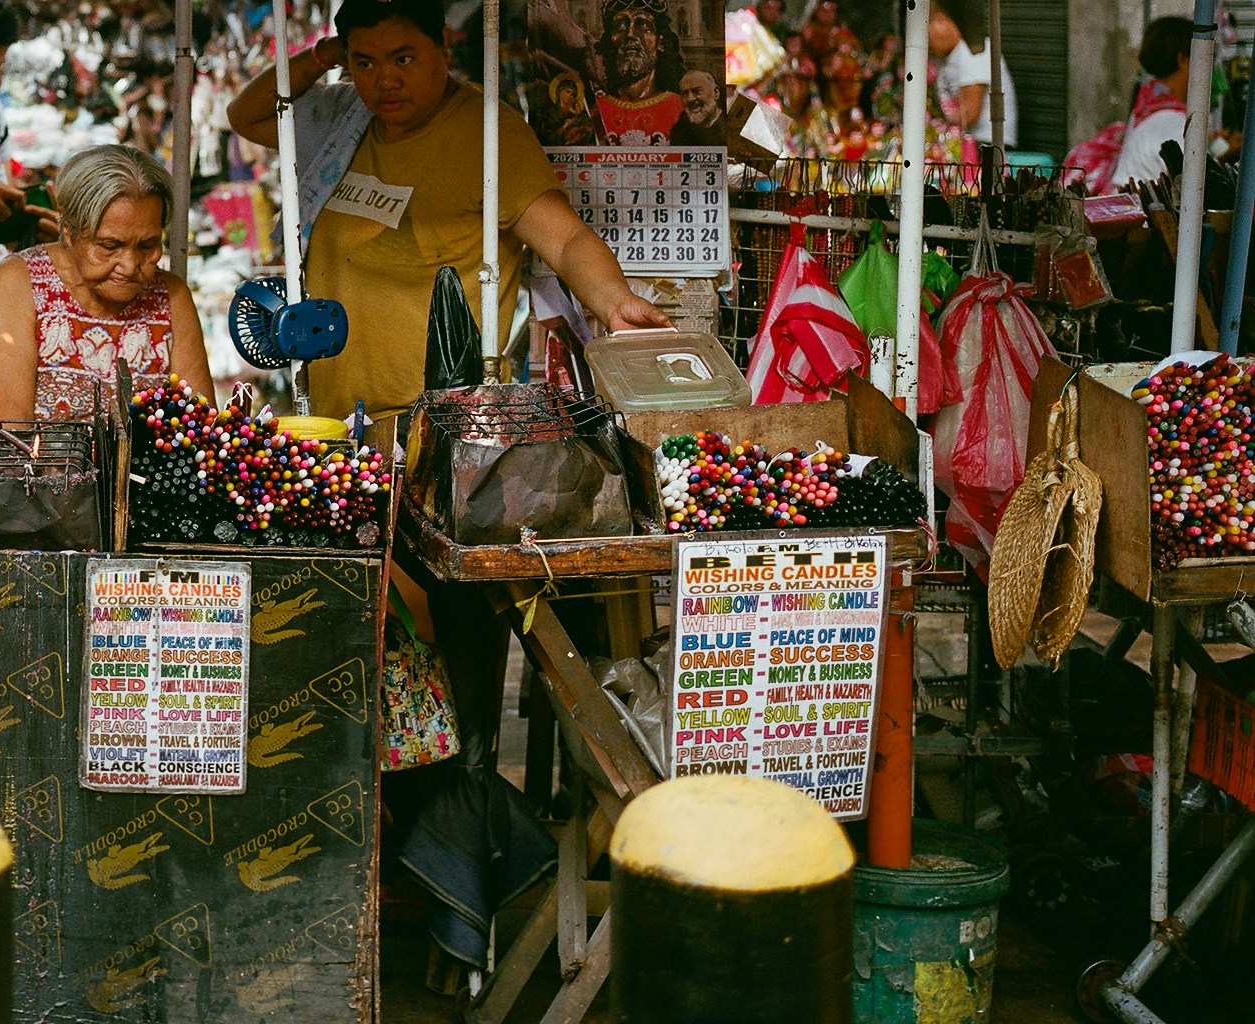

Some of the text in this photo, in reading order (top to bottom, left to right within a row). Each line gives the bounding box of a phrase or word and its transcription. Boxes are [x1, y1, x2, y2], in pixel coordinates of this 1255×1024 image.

[553, 153, 717, 162] 2026 JANUARY 2026
[656, 171, 716, 186] 1 2 3
[365, 190, 403, 213] OUT
[581, 190, 719, 205] 5 6 7 8 9 10
[578, 209, 718, 223] 12 13 14 15 16 17
[600, 228, 719, 242] 20 21 22 23 24
[627, 247, 719, 260] 28 29 30 31
[689, 551, 875, 569] BETH
[685, 564, 877, 584] WISHING CANDLES
[95, 583, 241, 598] WISHING CANDLES
[689, 580, 873, 595] COLORS MEANING
[98, 596, 239, 607] COLORS MEANING
[683, 591, 878, 615] RAINBOW WISHING CANDLE
[93, 607, 152, 622] RAINBOW
[681, 614, 756, 634] WHITE
[92, 635, 195, 649] BLUE PEACE
[682, 627, 875, 651] BLUE PEACE OF MIND
[91, 648, 242, 665] ORANGE SUCCESS
[680, 644, 874, 670] ORANGE SUCCESS
[91, 664, 148, 677] GREEN
[679, 662, 872, 689] GREEN MONEY BUSINESS
[90, 679, 146, 691] RED
[90, 694, 241, 709] YELLOW SOUL SPIRIT
[678, 683, 872, 709] RED HEALTH NAZARETH
[90, 707, 241, 722] PINK LOVE LIFE
[677, 701, 871, 730] YELLOW SOUL SPIRIT
[90, 720, 147, 733] PEACH
[676, 719, 869, 746] PINK LOVE LIFE
[89, 734, 191, 748] BROWN TRAVEL
[90, 748, 147, 760] VIOLET
[677, 735, 868, 763] PEACH STUDIES EXAMS
[89, 761, 240, 774] BLACK CONSCIENCE
[763, 751, 866, 773] TRAVEL FORTUNE
[817, 768, 864, 786] GROWTH
[72, 808, 157, 865] CROCODILE
[223, 810, 309, 867] CROCODILE
